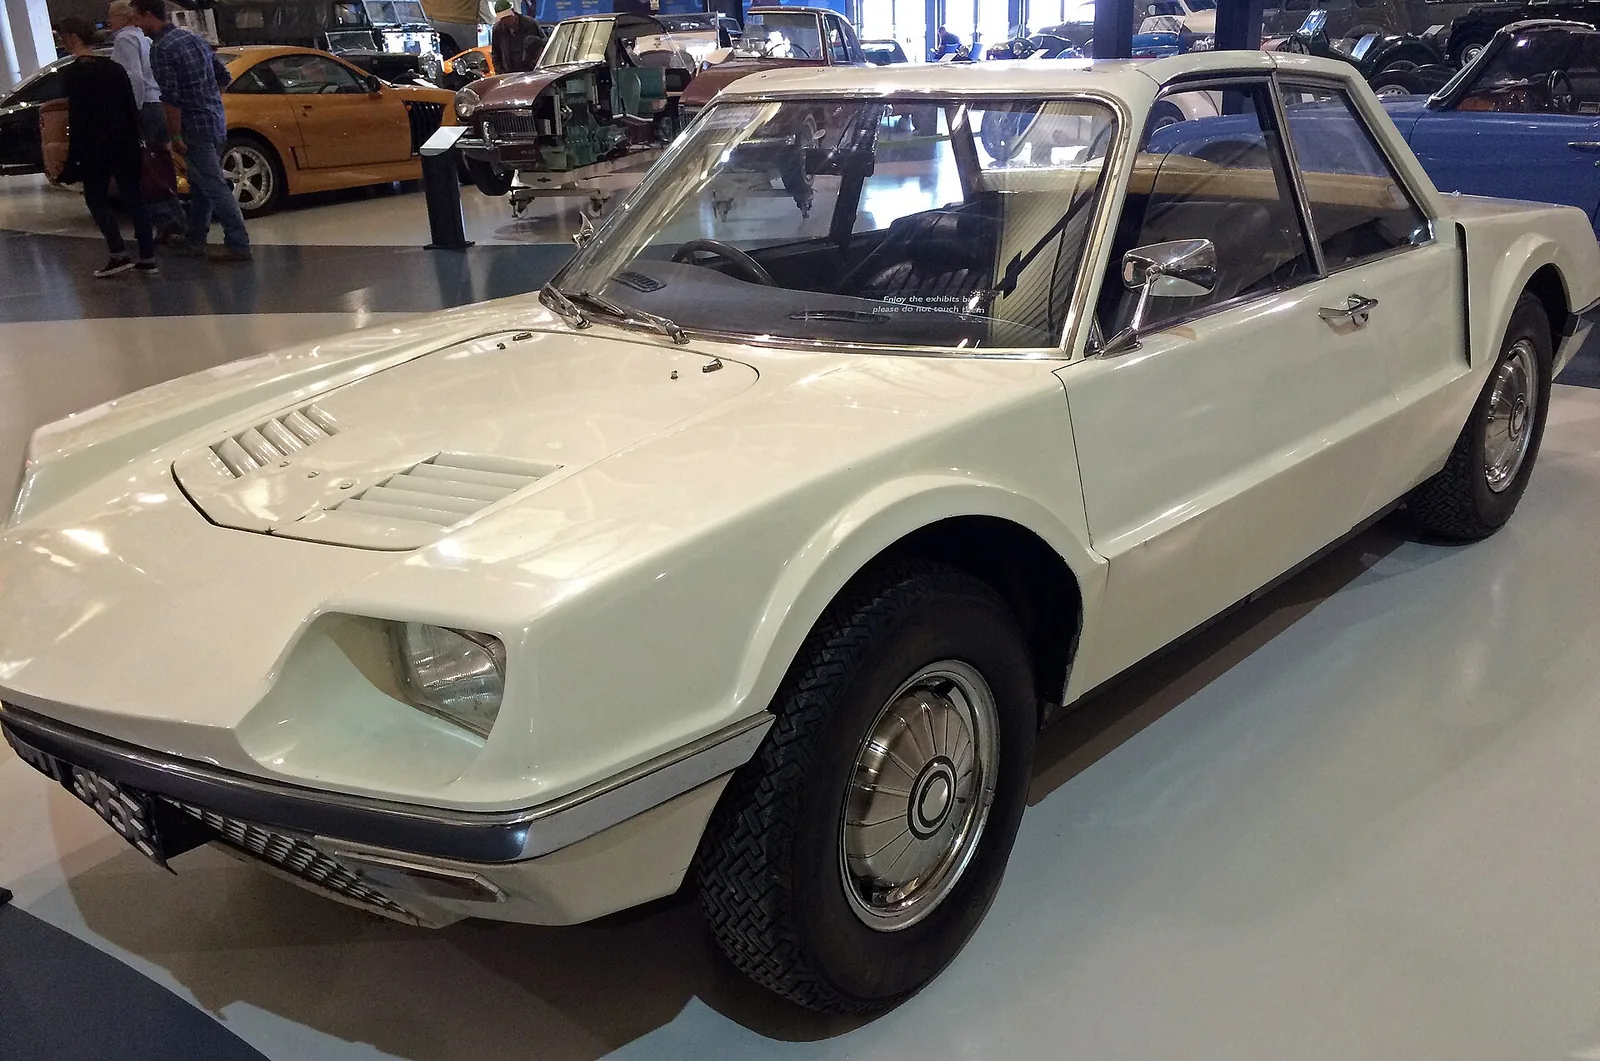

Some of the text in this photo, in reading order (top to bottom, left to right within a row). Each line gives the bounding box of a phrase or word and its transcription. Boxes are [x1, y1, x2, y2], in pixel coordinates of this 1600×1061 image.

[883, 295, 907, 304] Enjoy
[909, 295, 923, 303] the
[925, 295, 960, 303] exhibits
[872, 306, 899, 314] please
